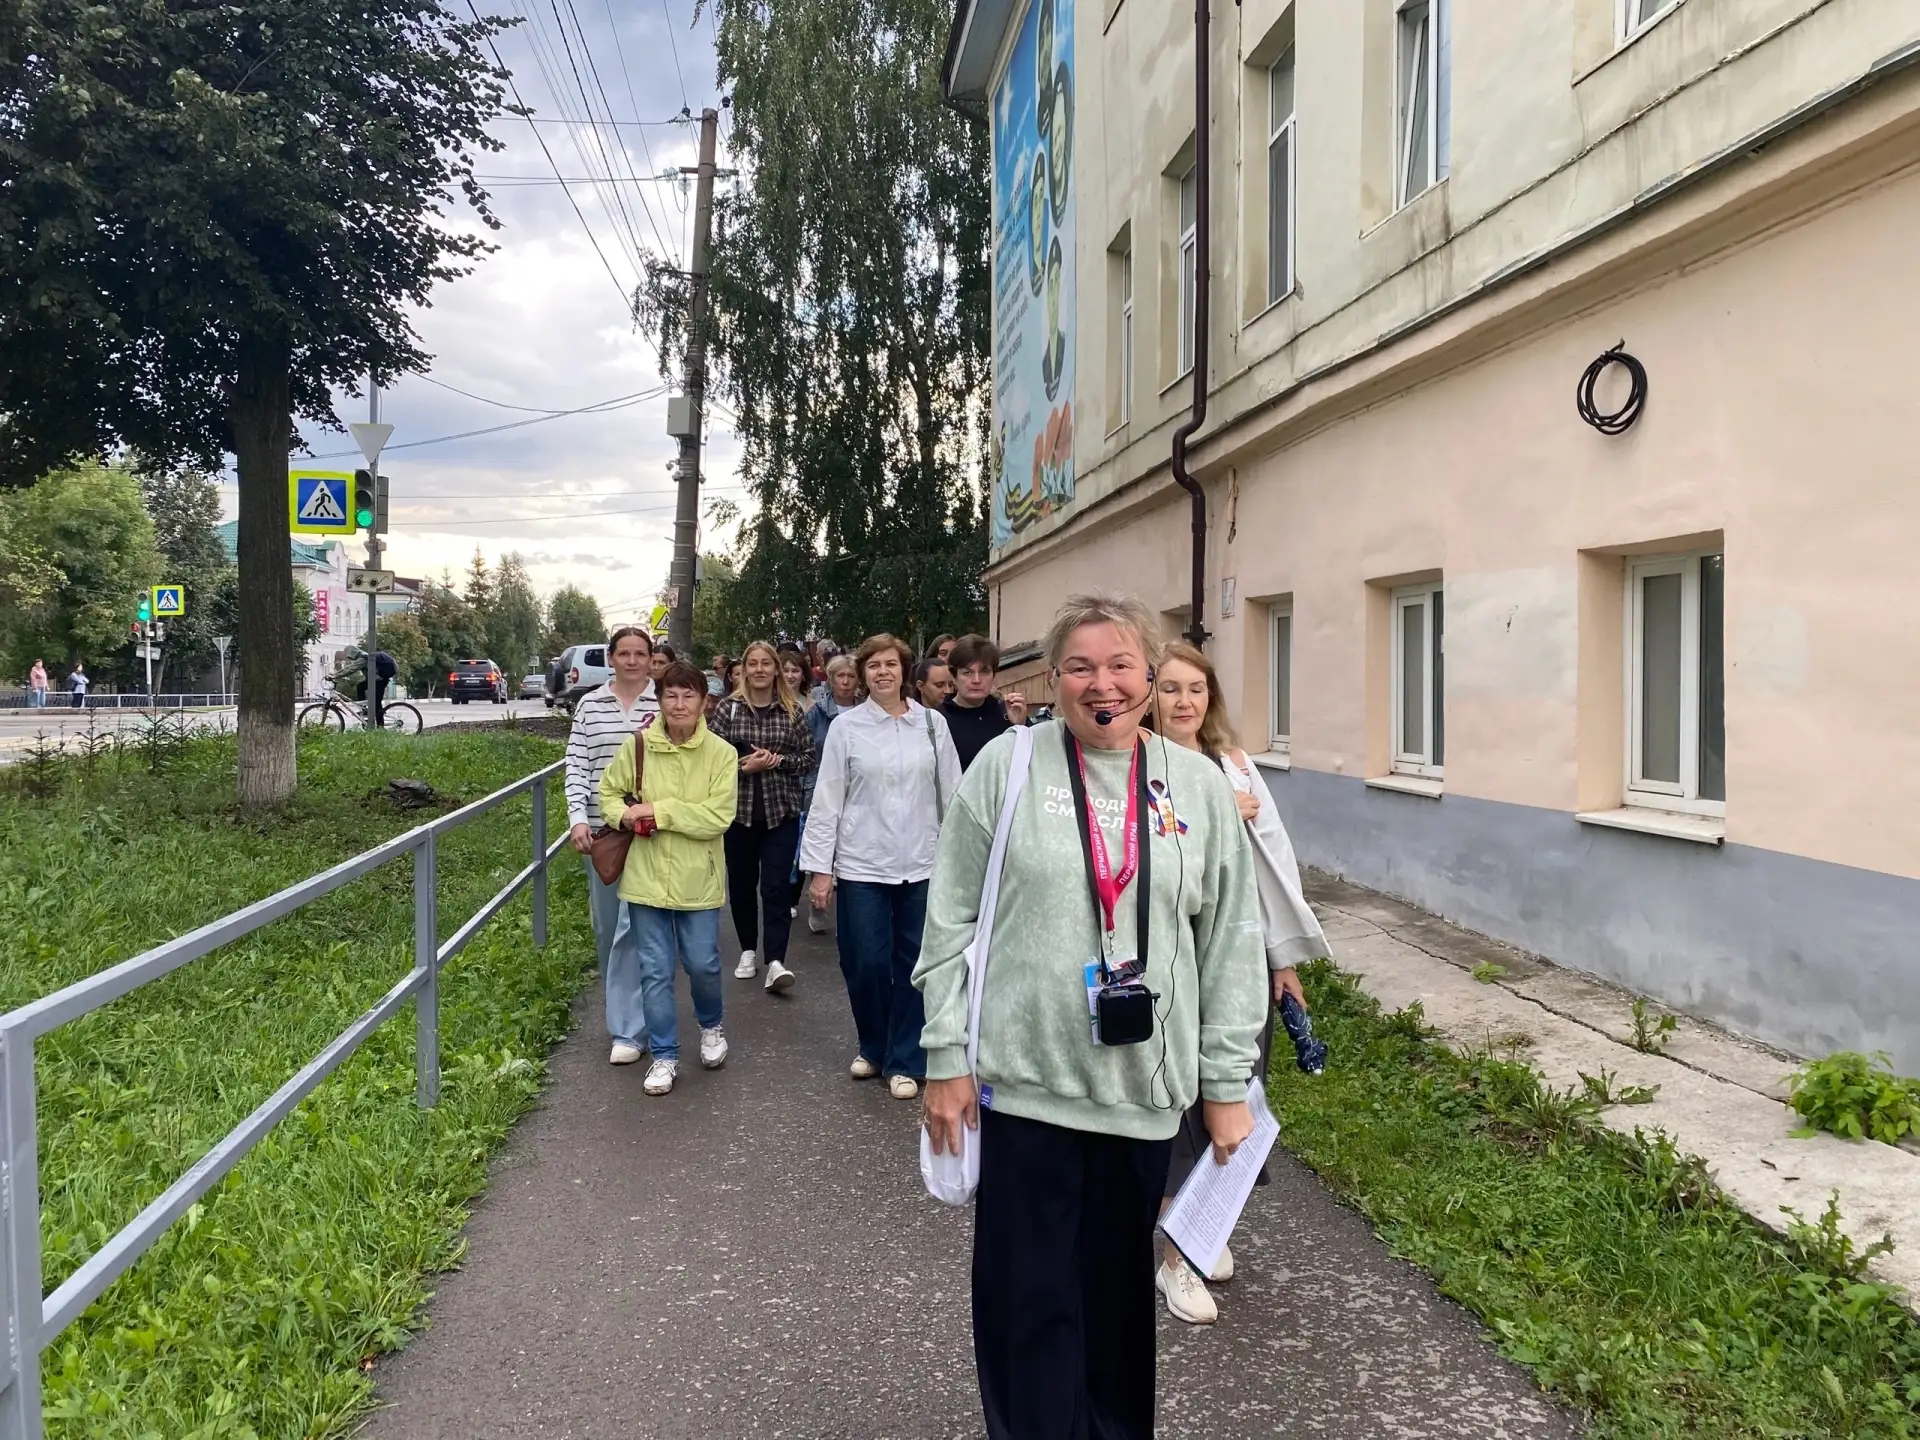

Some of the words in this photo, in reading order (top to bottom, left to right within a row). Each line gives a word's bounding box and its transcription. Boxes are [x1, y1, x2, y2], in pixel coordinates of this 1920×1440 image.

[1093, 833, 1108, 880] ПЕРМСКИЙ
[1118, 842, 1137, 885] ПЕРМСКИЙ
[1129, 821, 1138, 841] КРАЙ
